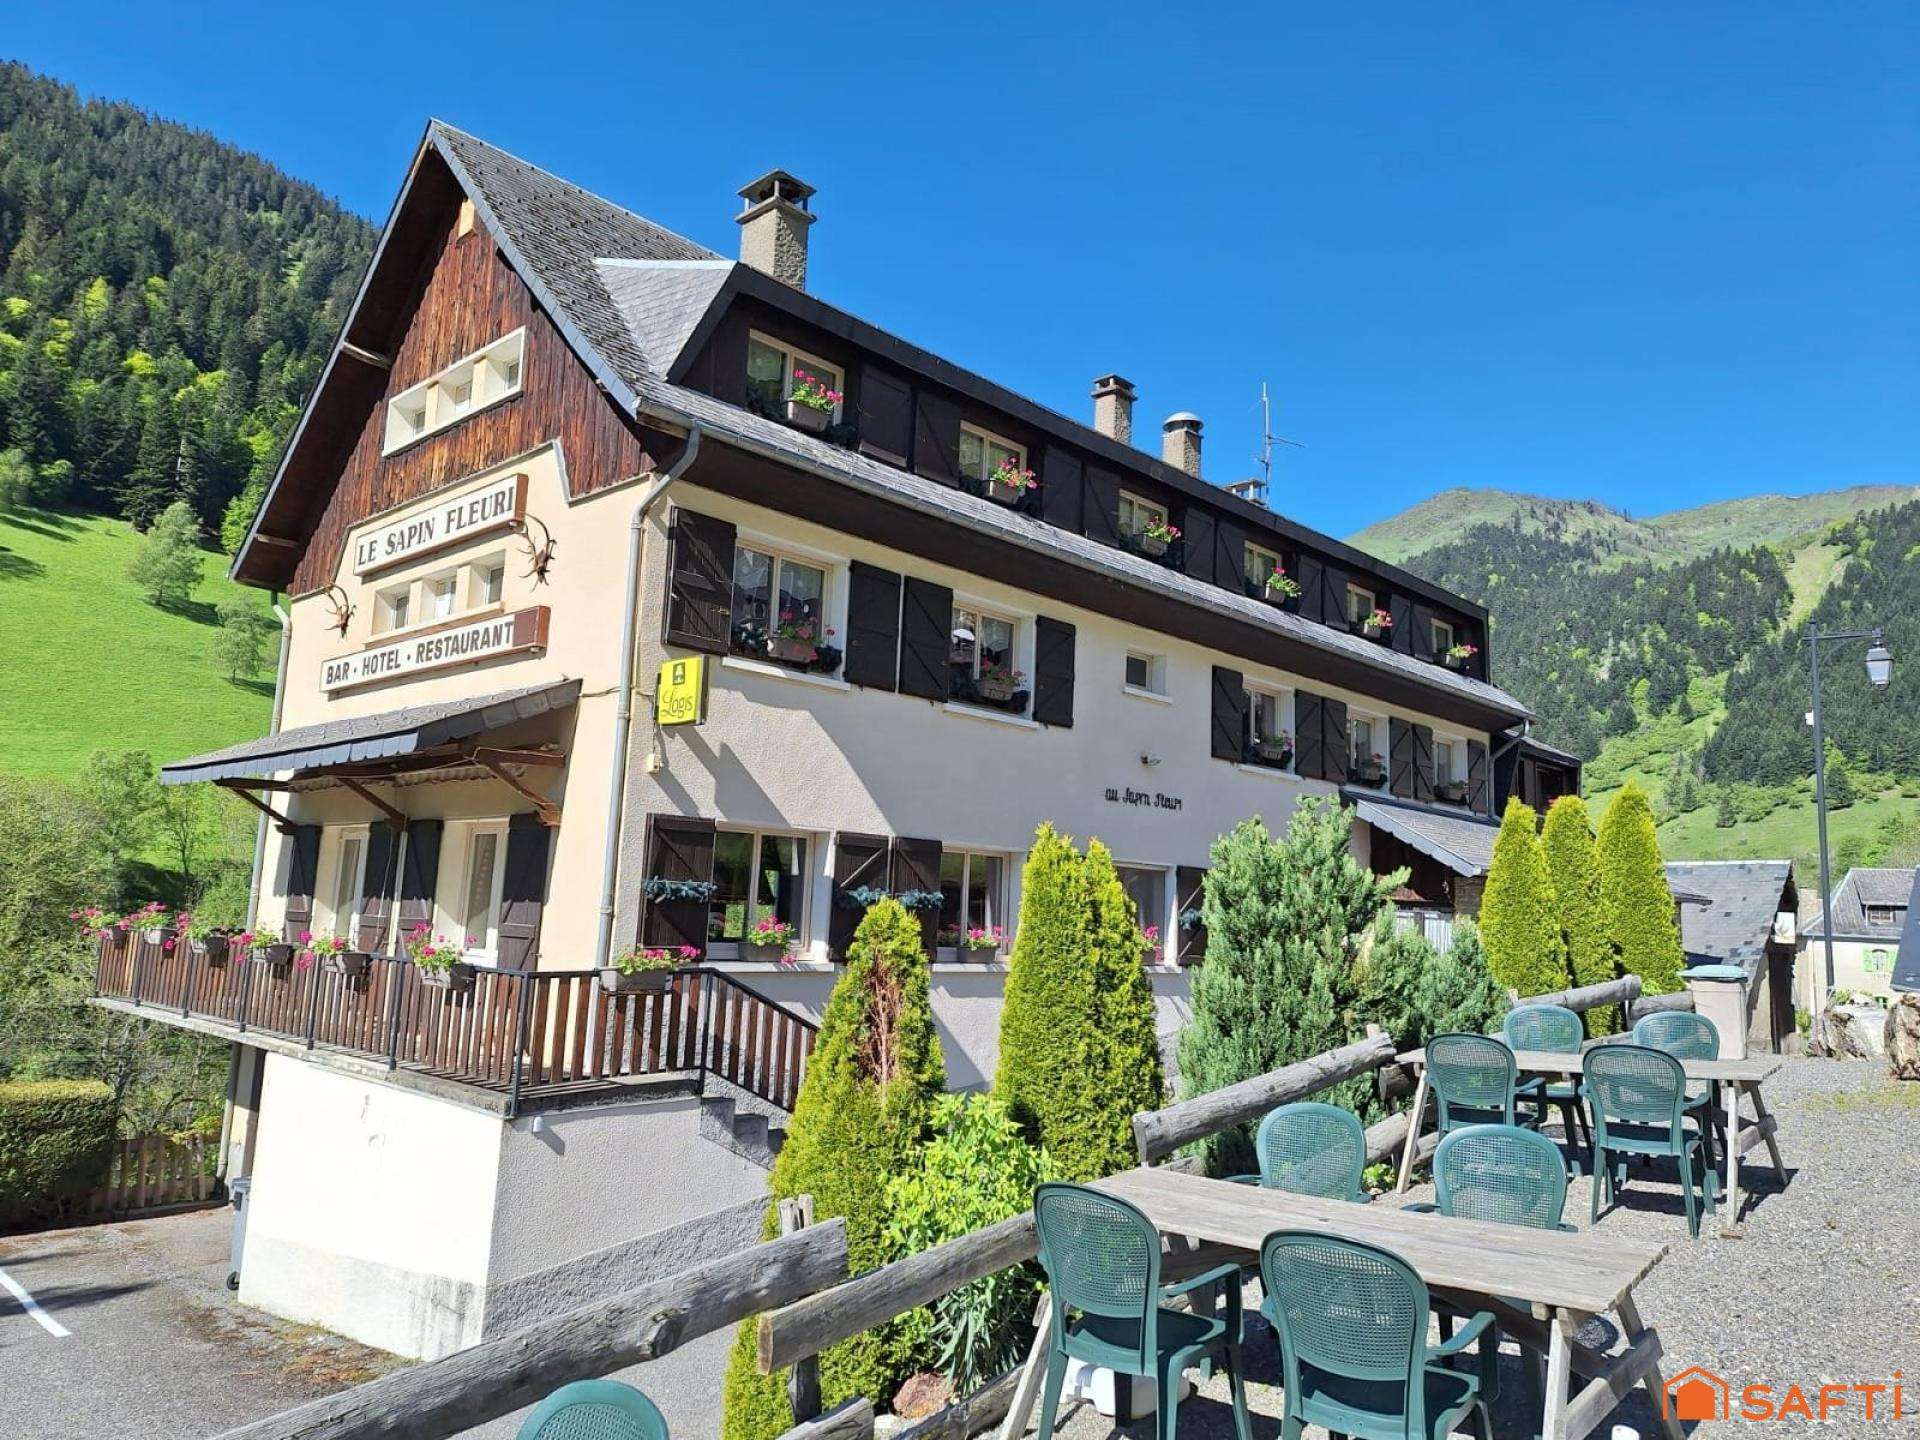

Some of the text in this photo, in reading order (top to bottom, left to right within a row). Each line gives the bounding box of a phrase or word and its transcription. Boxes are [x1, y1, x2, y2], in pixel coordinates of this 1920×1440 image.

[358, 486, 514, 566] LE SAPIN FLEURI
[326, 621, 514, 685] BAR HOTEL RESTAURANT
